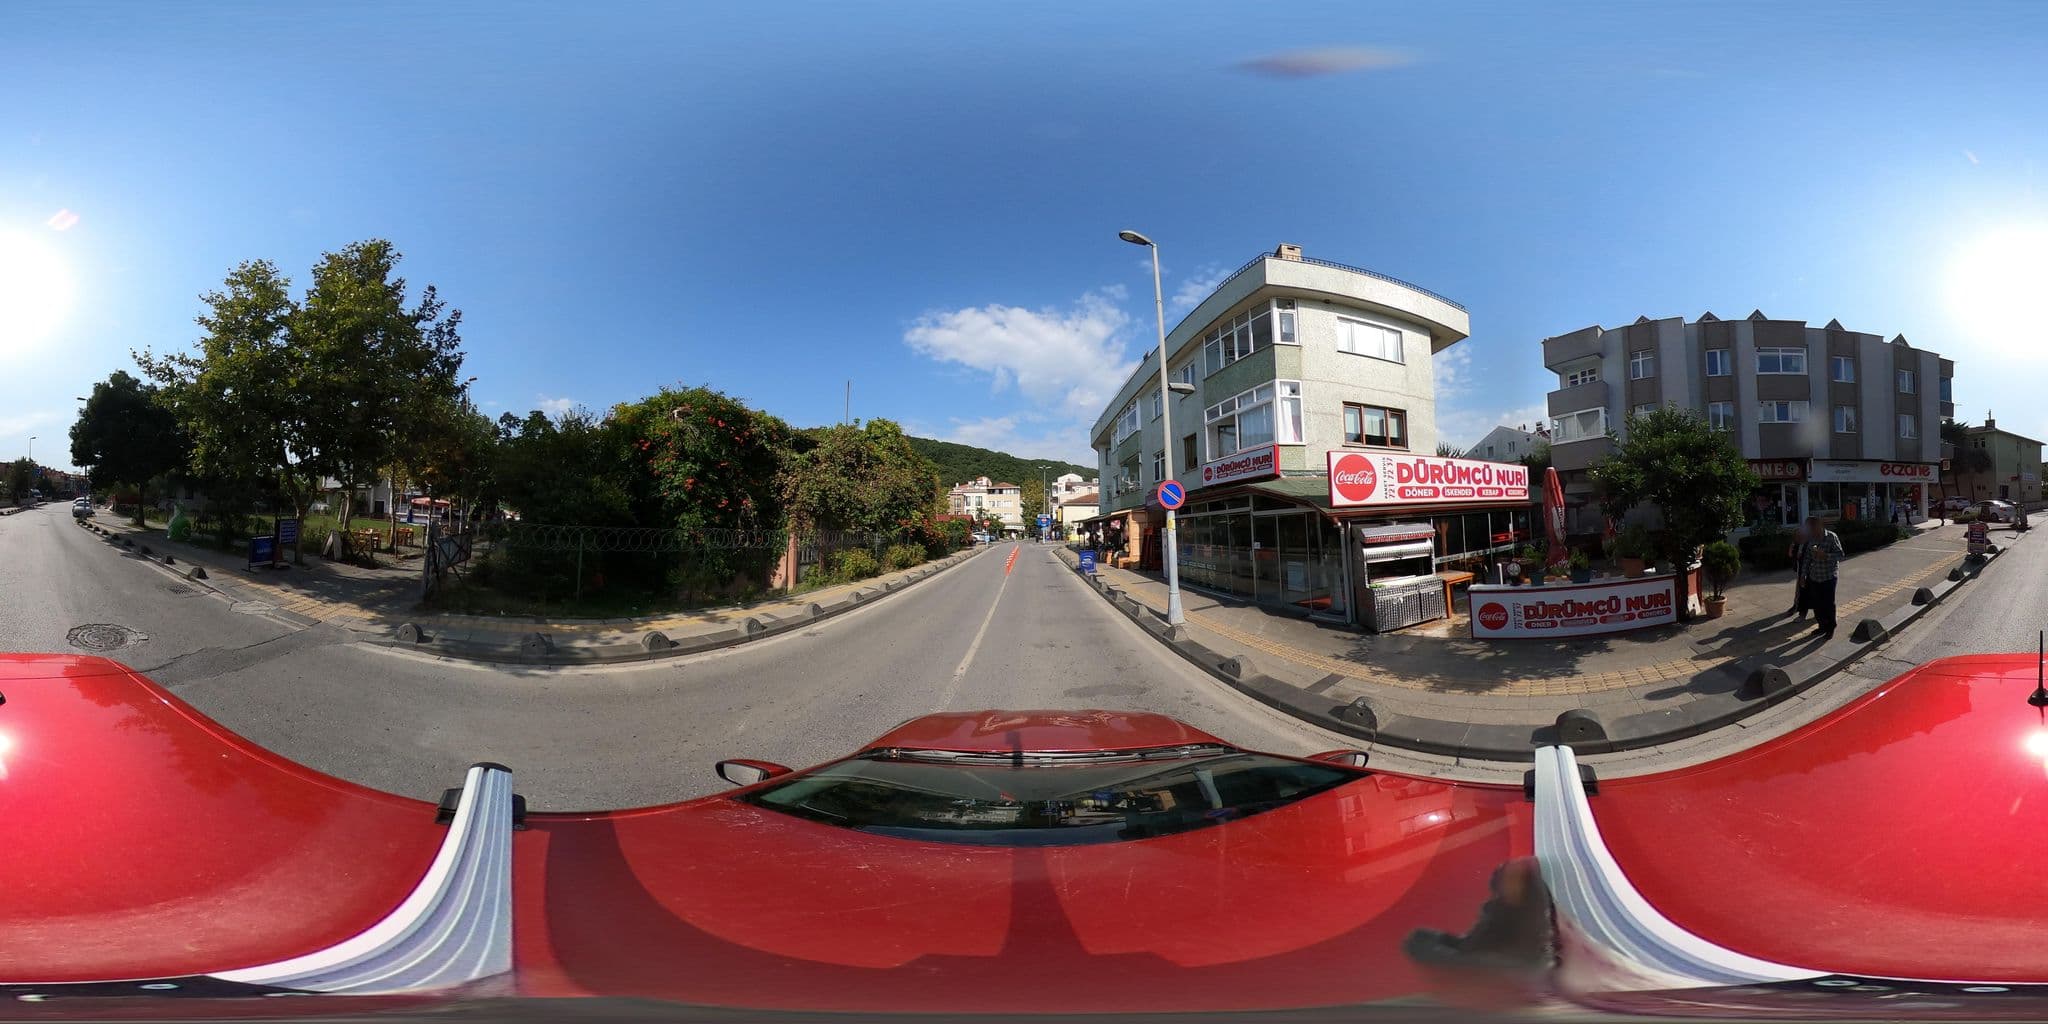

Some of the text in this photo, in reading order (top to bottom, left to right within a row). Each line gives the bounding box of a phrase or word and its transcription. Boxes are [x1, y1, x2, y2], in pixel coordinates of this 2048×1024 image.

[1335, 470, 1375, 485] Coca-Cola
[1397, 459, 1526, 486] DÜRÜMCÜ NURİ
[1405, 486, 1433, 497] DÖNER
[1524, 596, 1621, 619] DÜRÜMCÜ
[1626, 589, 1671, 611] NURİ
[1480, 611, 1507, 621] Coca-Cola
